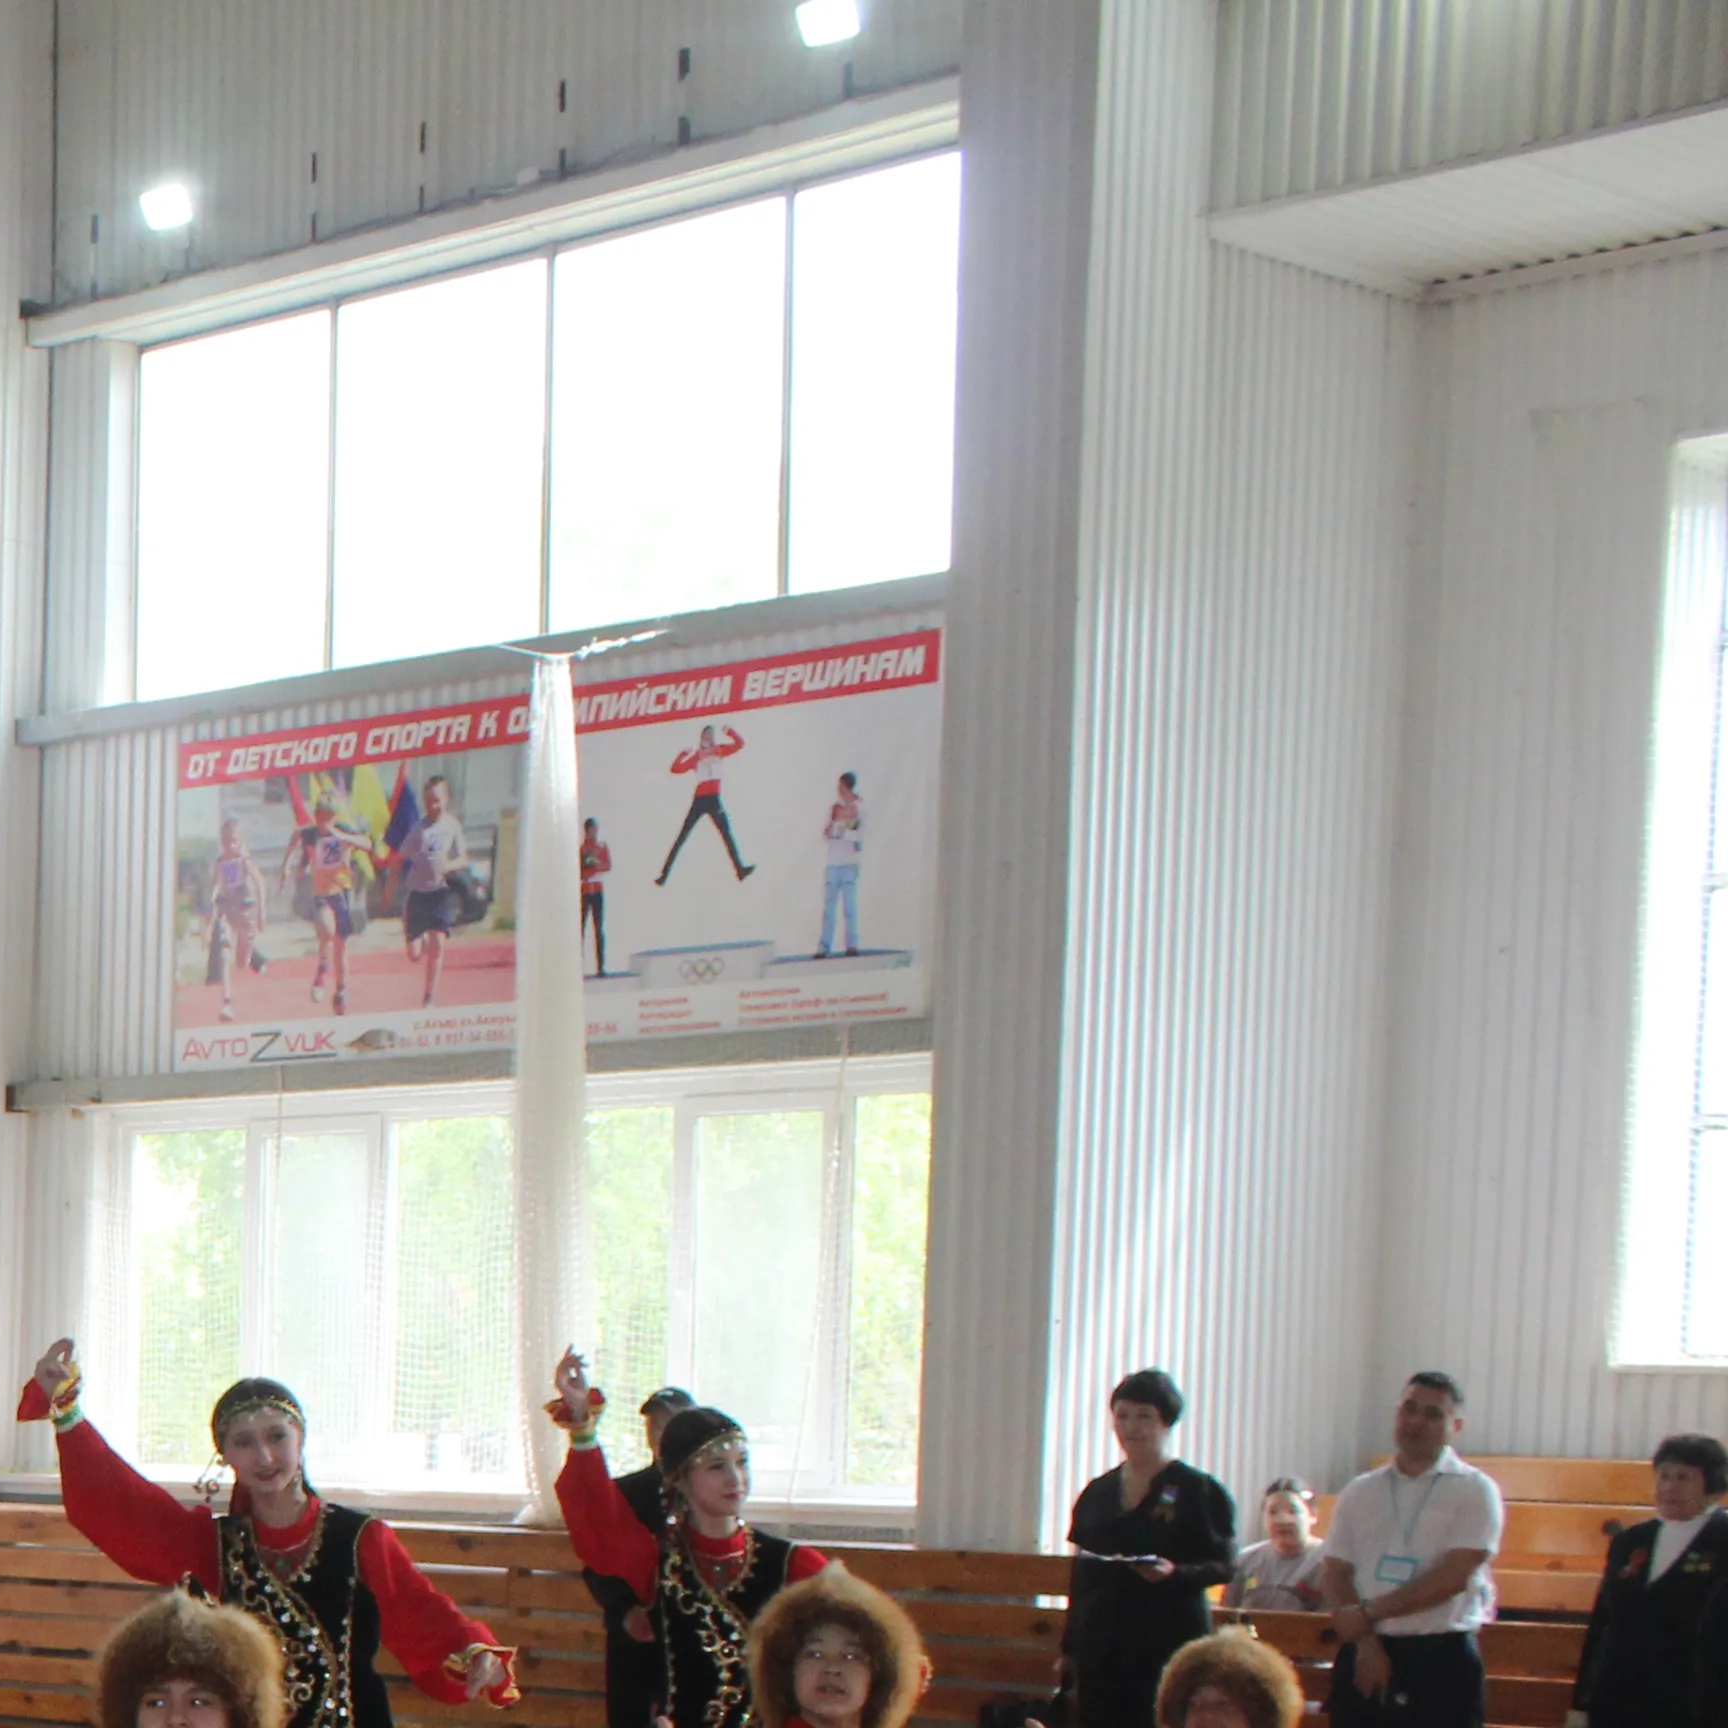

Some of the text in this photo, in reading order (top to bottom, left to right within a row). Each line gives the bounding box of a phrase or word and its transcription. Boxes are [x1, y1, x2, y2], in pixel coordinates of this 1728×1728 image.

[187, 751, 221, 780] ОТ
[226, 732, 358, 774] ДЕТСКОГО
[364, 713, 472, 754] СПОРТА
[476, 709, 500, 740] К
[743, 644, 928, 701] ВЕРШИНАМ
